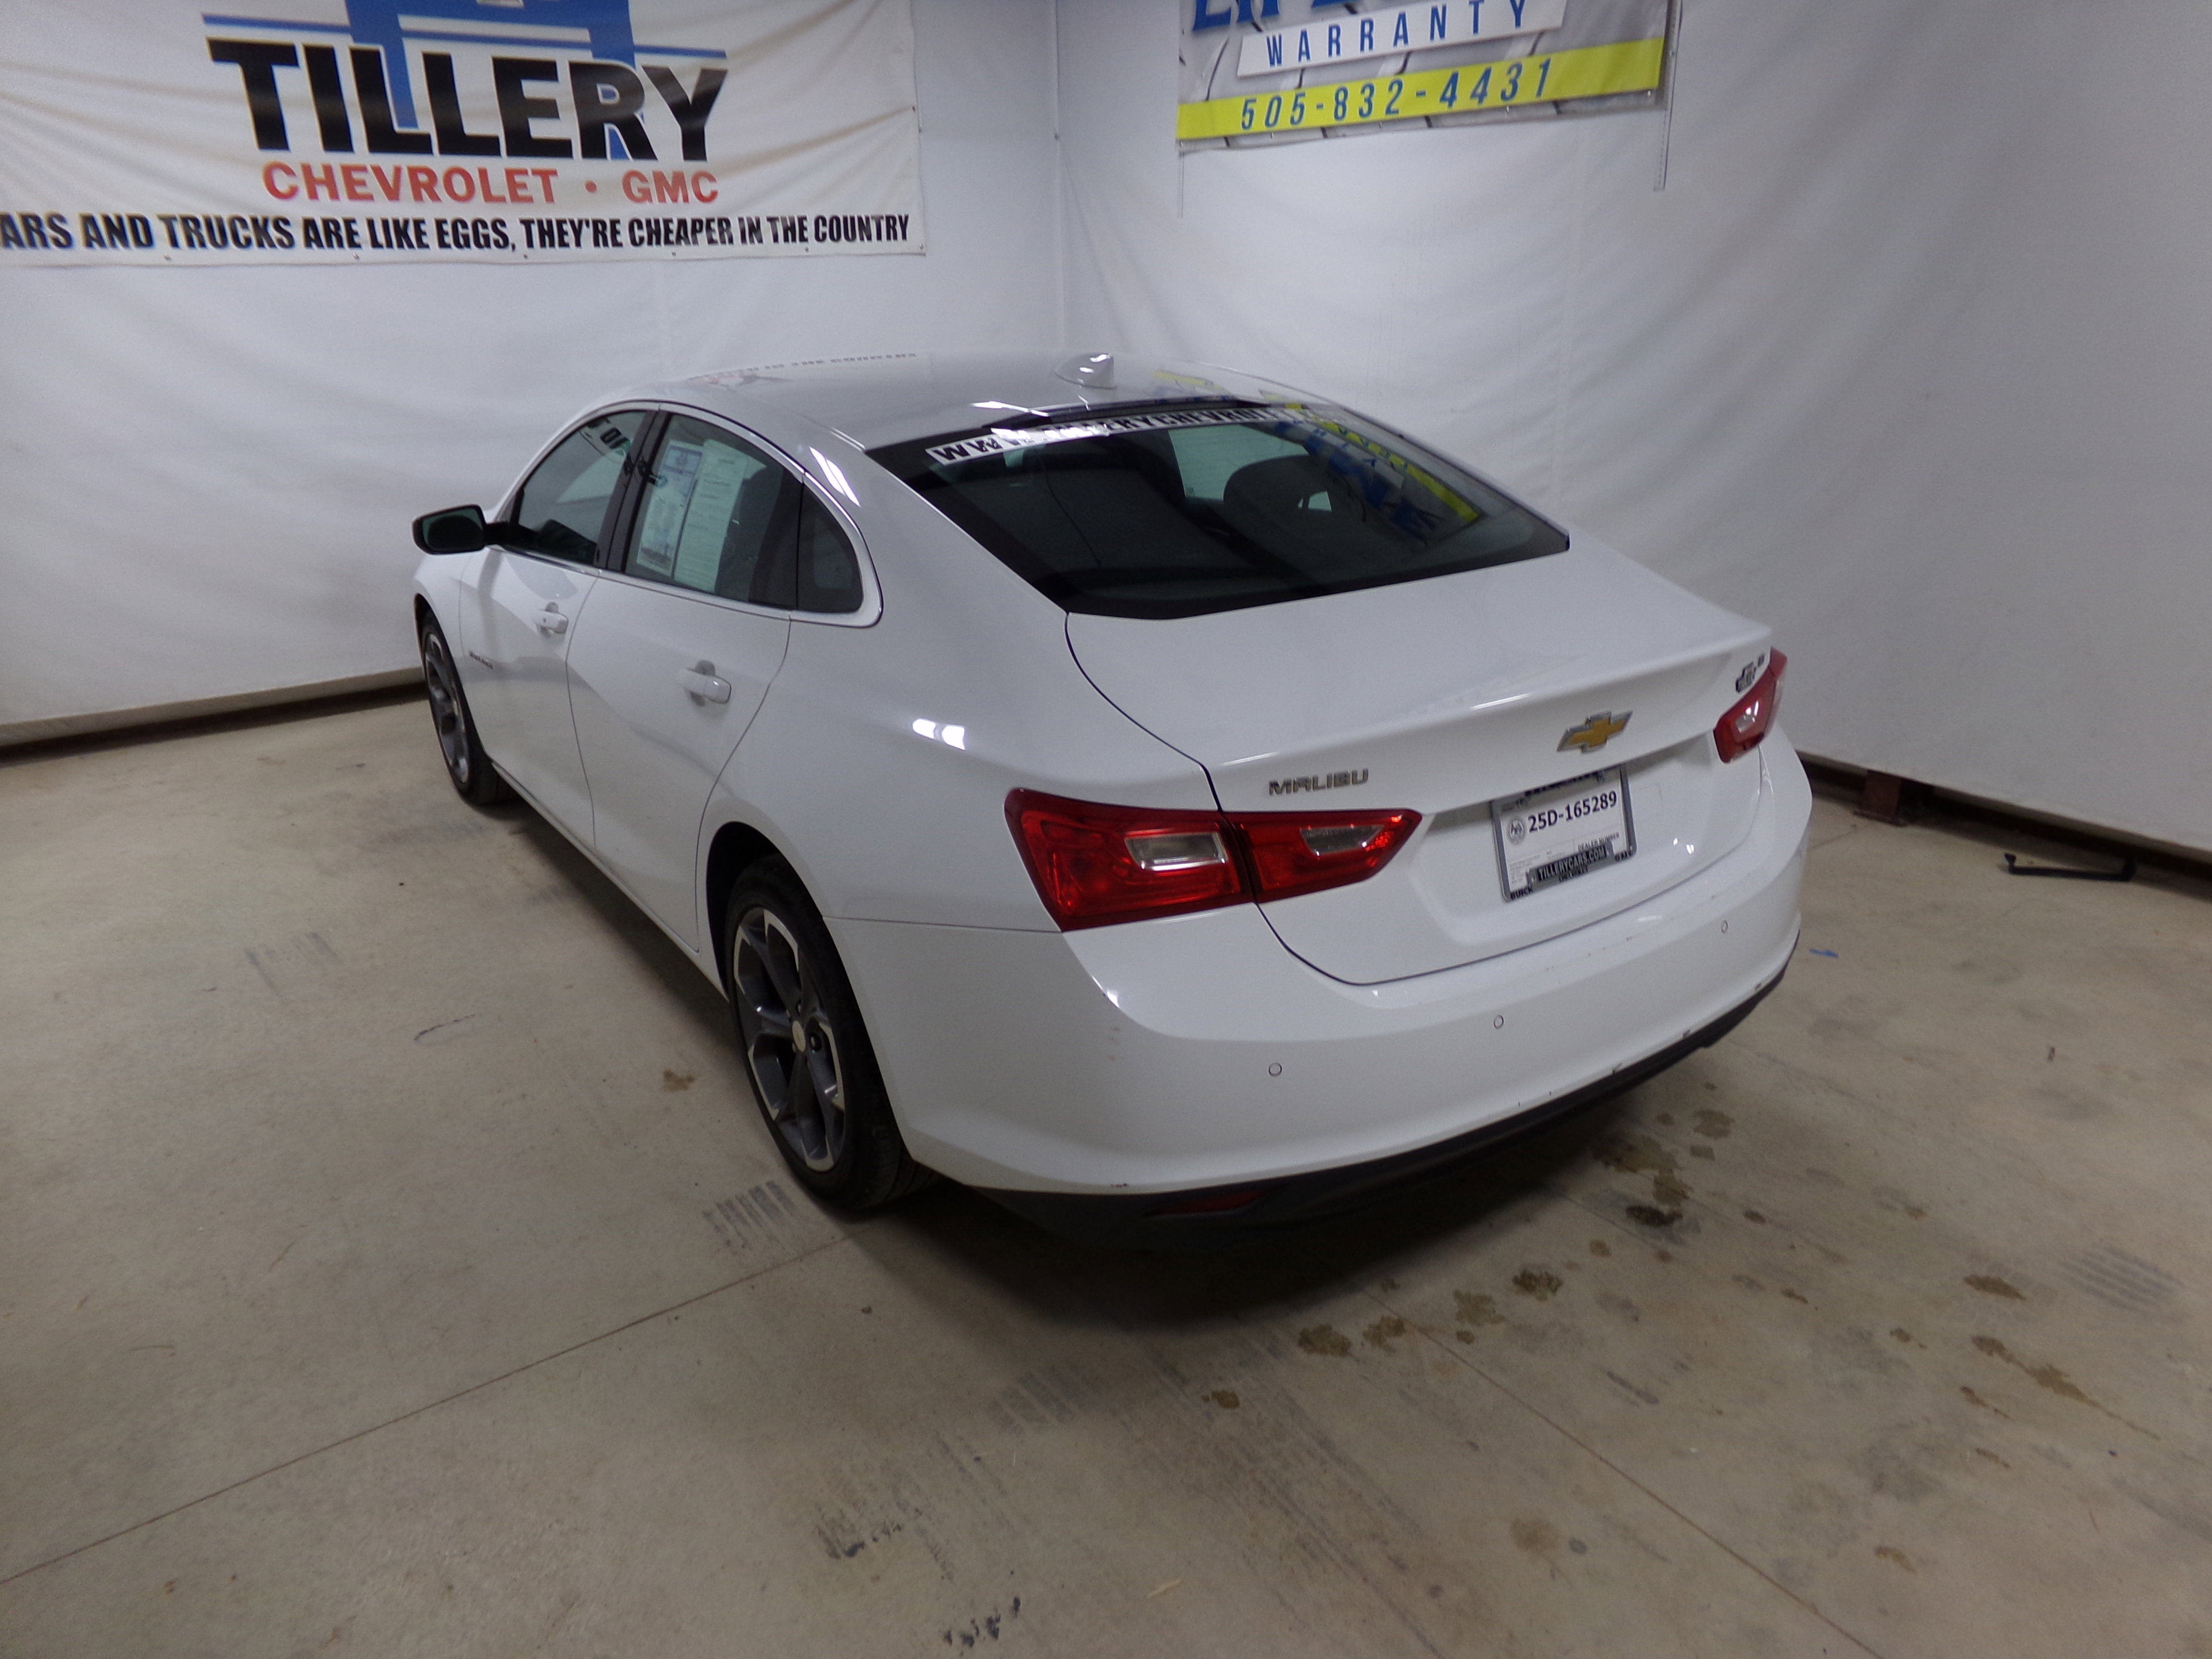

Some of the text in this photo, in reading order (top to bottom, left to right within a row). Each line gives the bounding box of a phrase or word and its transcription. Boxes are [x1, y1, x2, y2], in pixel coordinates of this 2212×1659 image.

[1266, 0, 1525, 67] WARRANTY
[205, 36, 728, 162] TILLERY
[1240, 58, 1551, 131] 505-832-4431
[263, 160, 719, 205] CHEVROLET GMC
[79, 213, 155, 250] AND
[157, 214, 295, 250] TRUCKS
[302, 216, 362, 250] ARE
[366, 217, 430, 250] LIKE
[435, 217, 517, 252] EGGS,
[518, 218, 624, 249] THEY'RE
[630, 216, 734, 248] CHEAPER
[737, 216, 763, 245] IN
[767, 216, 810, 243] THE
[814, 214, 910, 242] COUNTRY
[1269, 768, 1369, 796] MALIBU
[1527, 790, 1617, 833] 25D-165289
[1577, 832, 1620, 852] DEALER NUMBER
[1538, 847, 1607, 881] TILLERYCARS.COM
